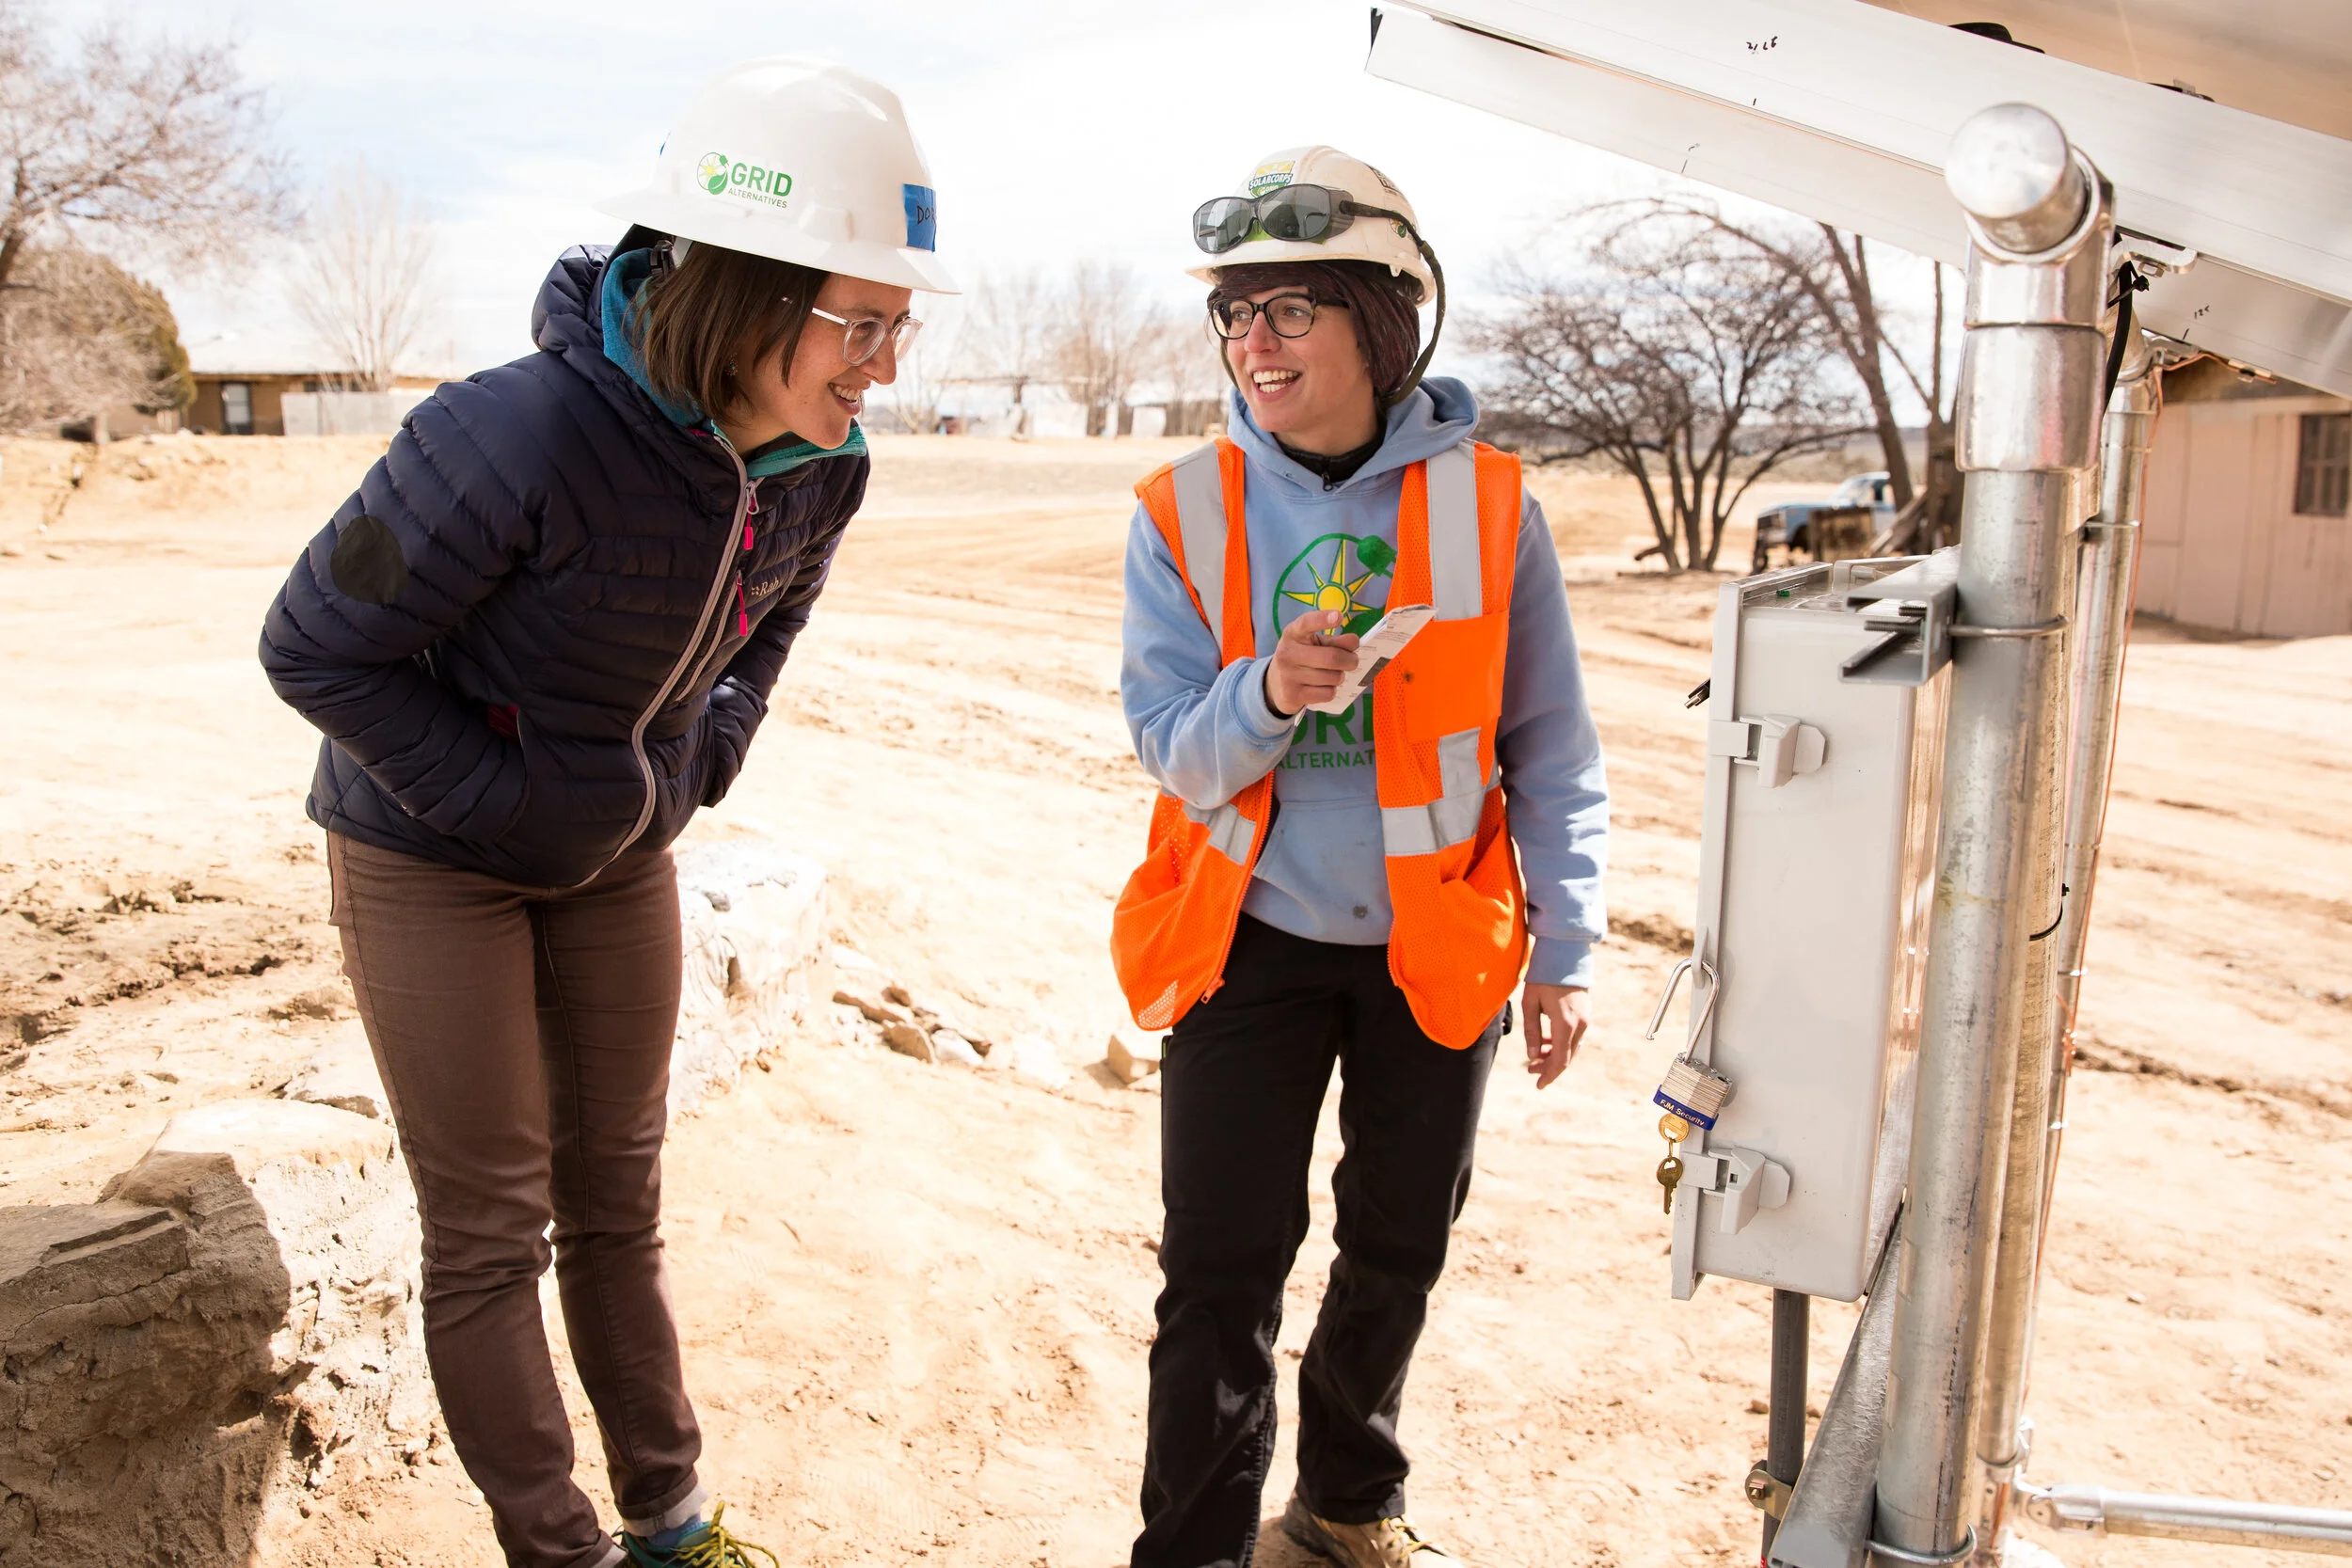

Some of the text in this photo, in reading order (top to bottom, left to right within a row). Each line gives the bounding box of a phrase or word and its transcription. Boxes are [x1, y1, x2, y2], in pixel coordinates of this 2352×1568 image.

[731, 162, 792, 198] GRID
[728, 187, 787, 209] ALTERNATIVES
[1291, 693, 1375, 745] RI
[1279, 749, 1375, 769] LTERNAT
[1660, 1099, 1705, 1126] FJM Security
